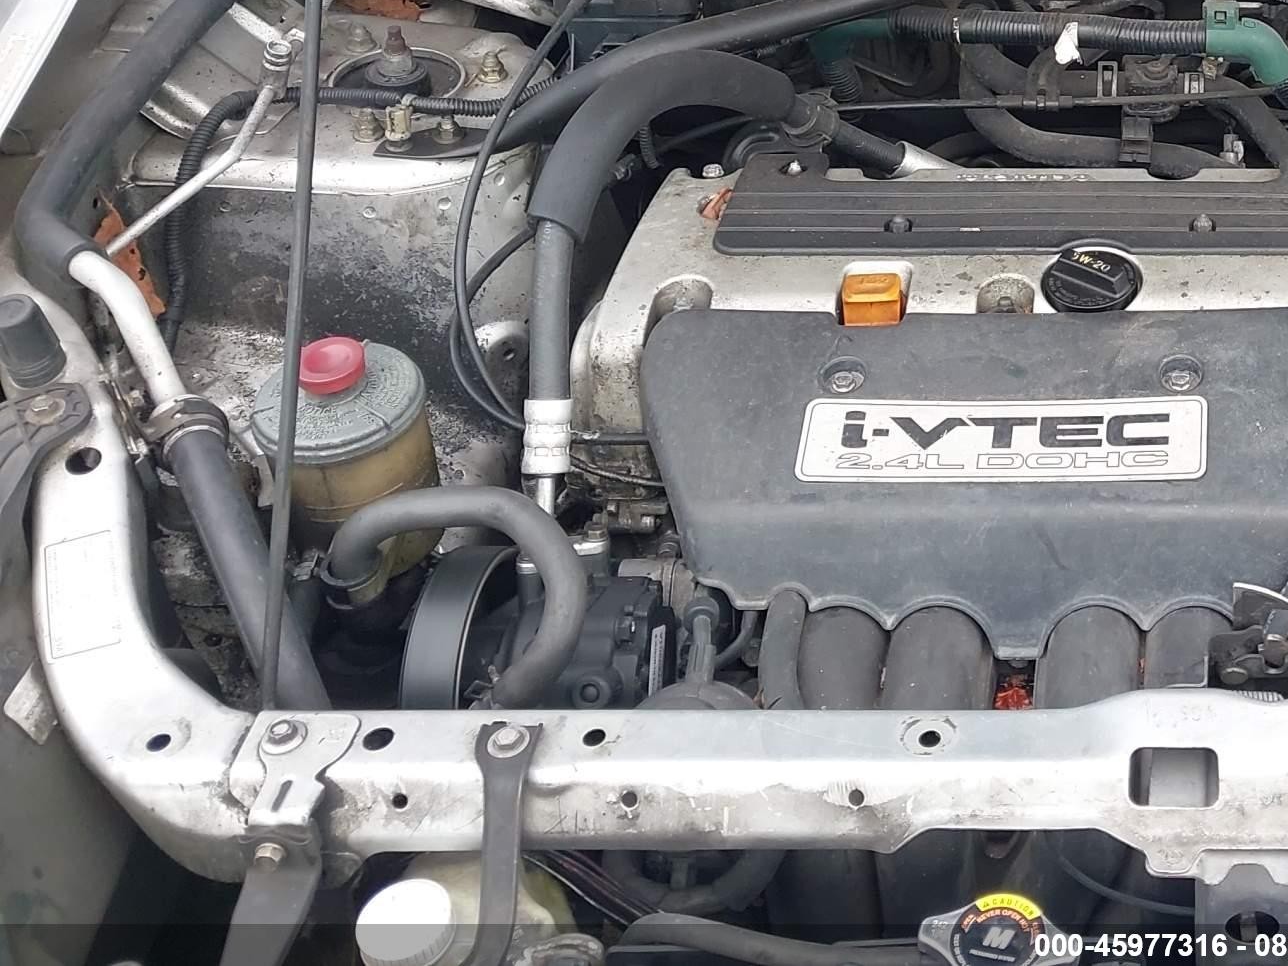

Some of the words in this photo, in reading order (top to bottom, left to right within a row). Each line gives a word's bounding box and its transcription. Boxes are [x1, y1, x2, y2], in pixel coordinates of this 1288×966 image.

[1071, 252, 1111, 273] 5W-20
[841, 411, 1170, 450] i-VTEC
[836, 452, 965, 470] 2.4L
[975, 450, 1170, 470] DOHC
[992, 897, 1035, 917] CAUTION
